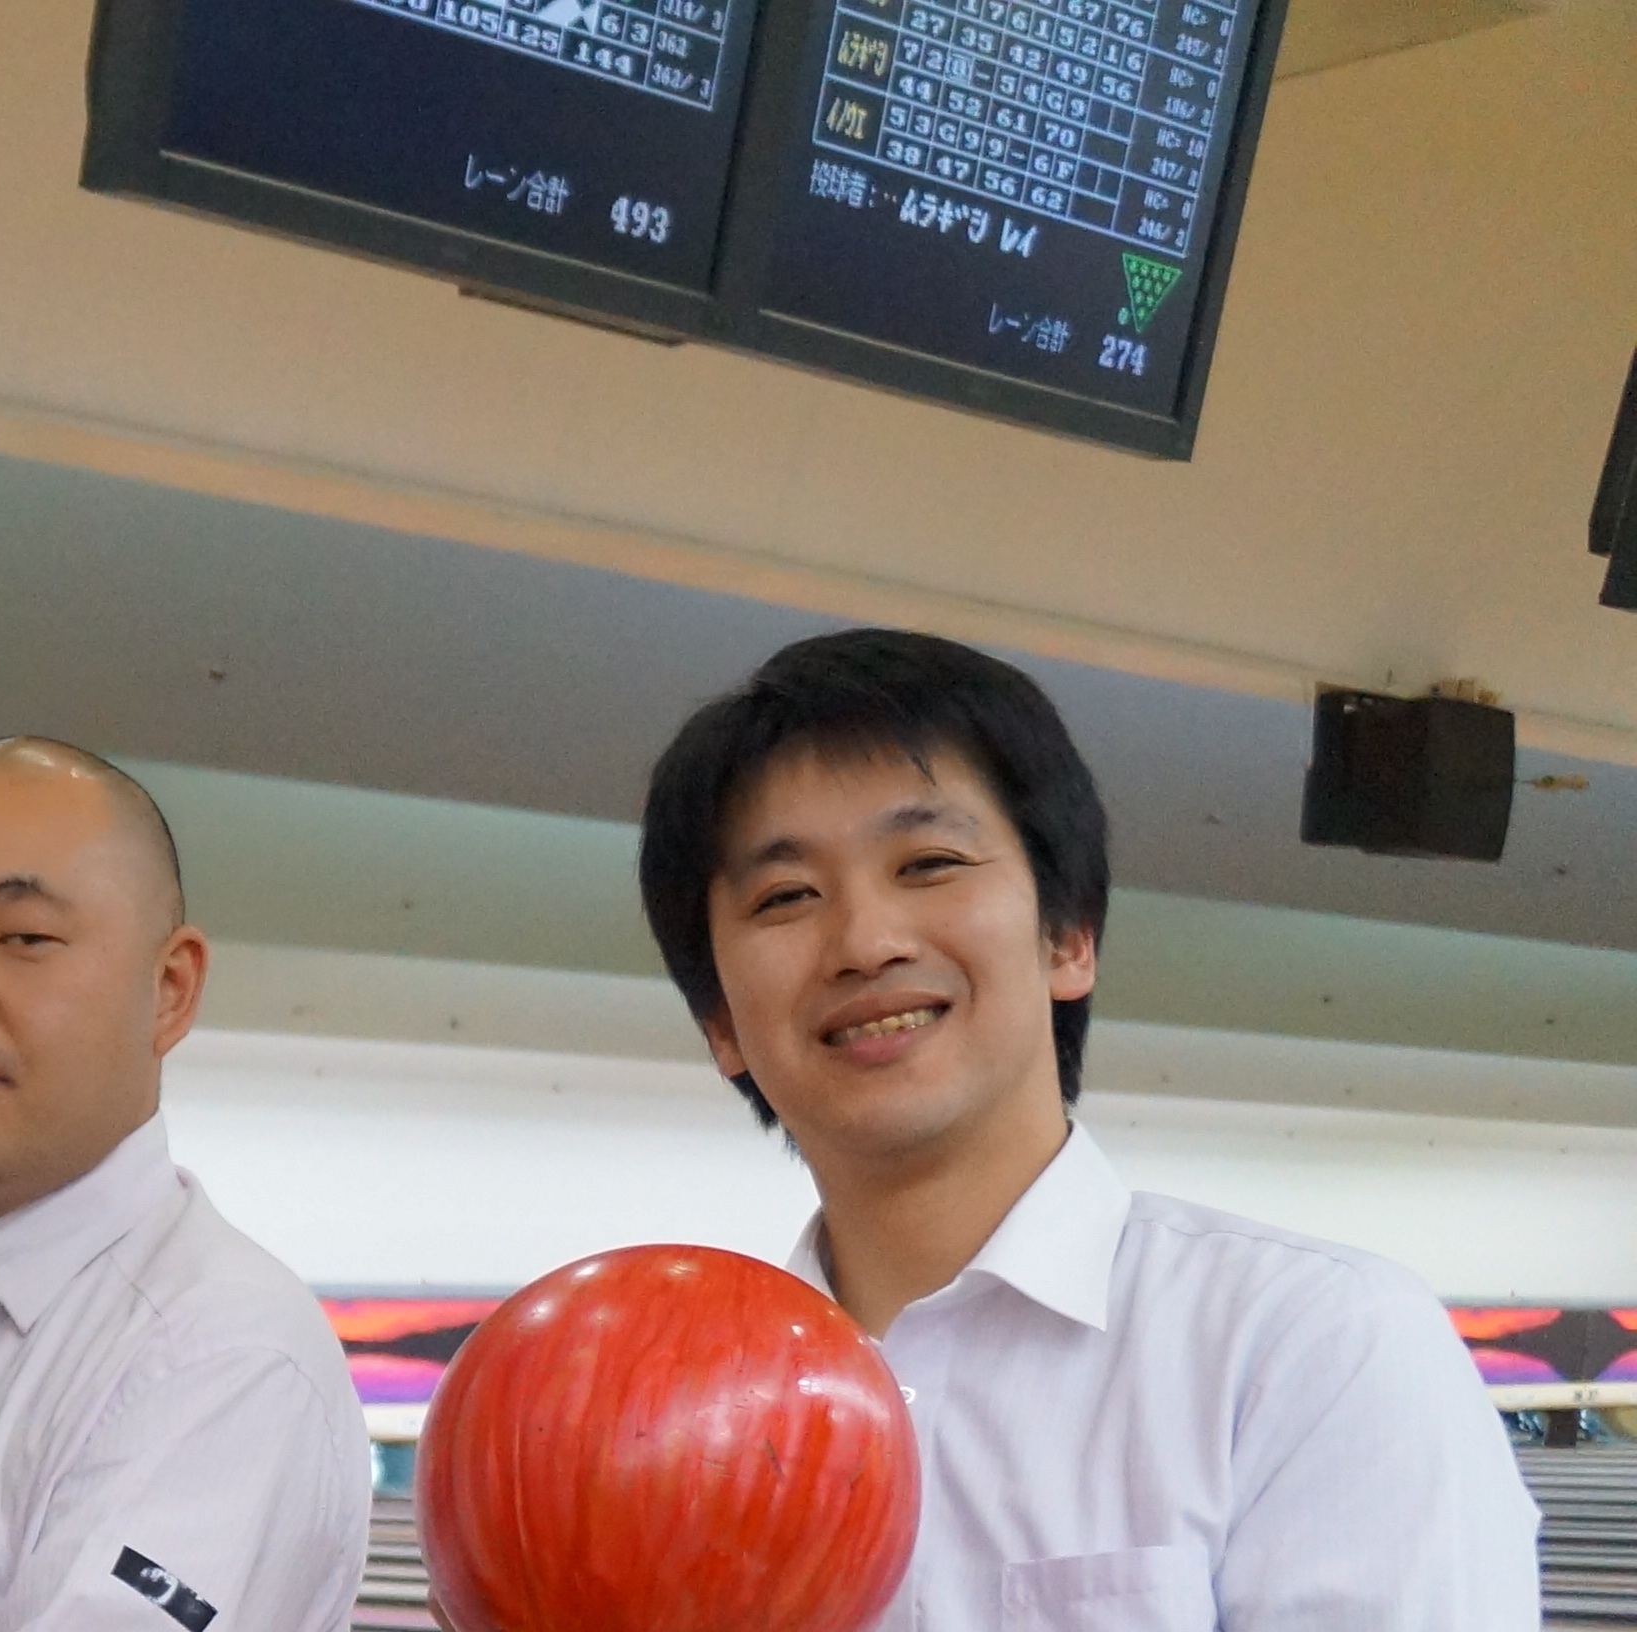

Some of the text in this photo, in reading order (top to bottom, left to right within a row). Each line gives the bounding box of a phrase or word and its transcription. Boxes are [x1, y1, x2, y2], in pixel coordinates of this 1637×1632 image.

[464, 153, 670, 244] レーン合計 493
[1098, 333, 1147, 376] 274
